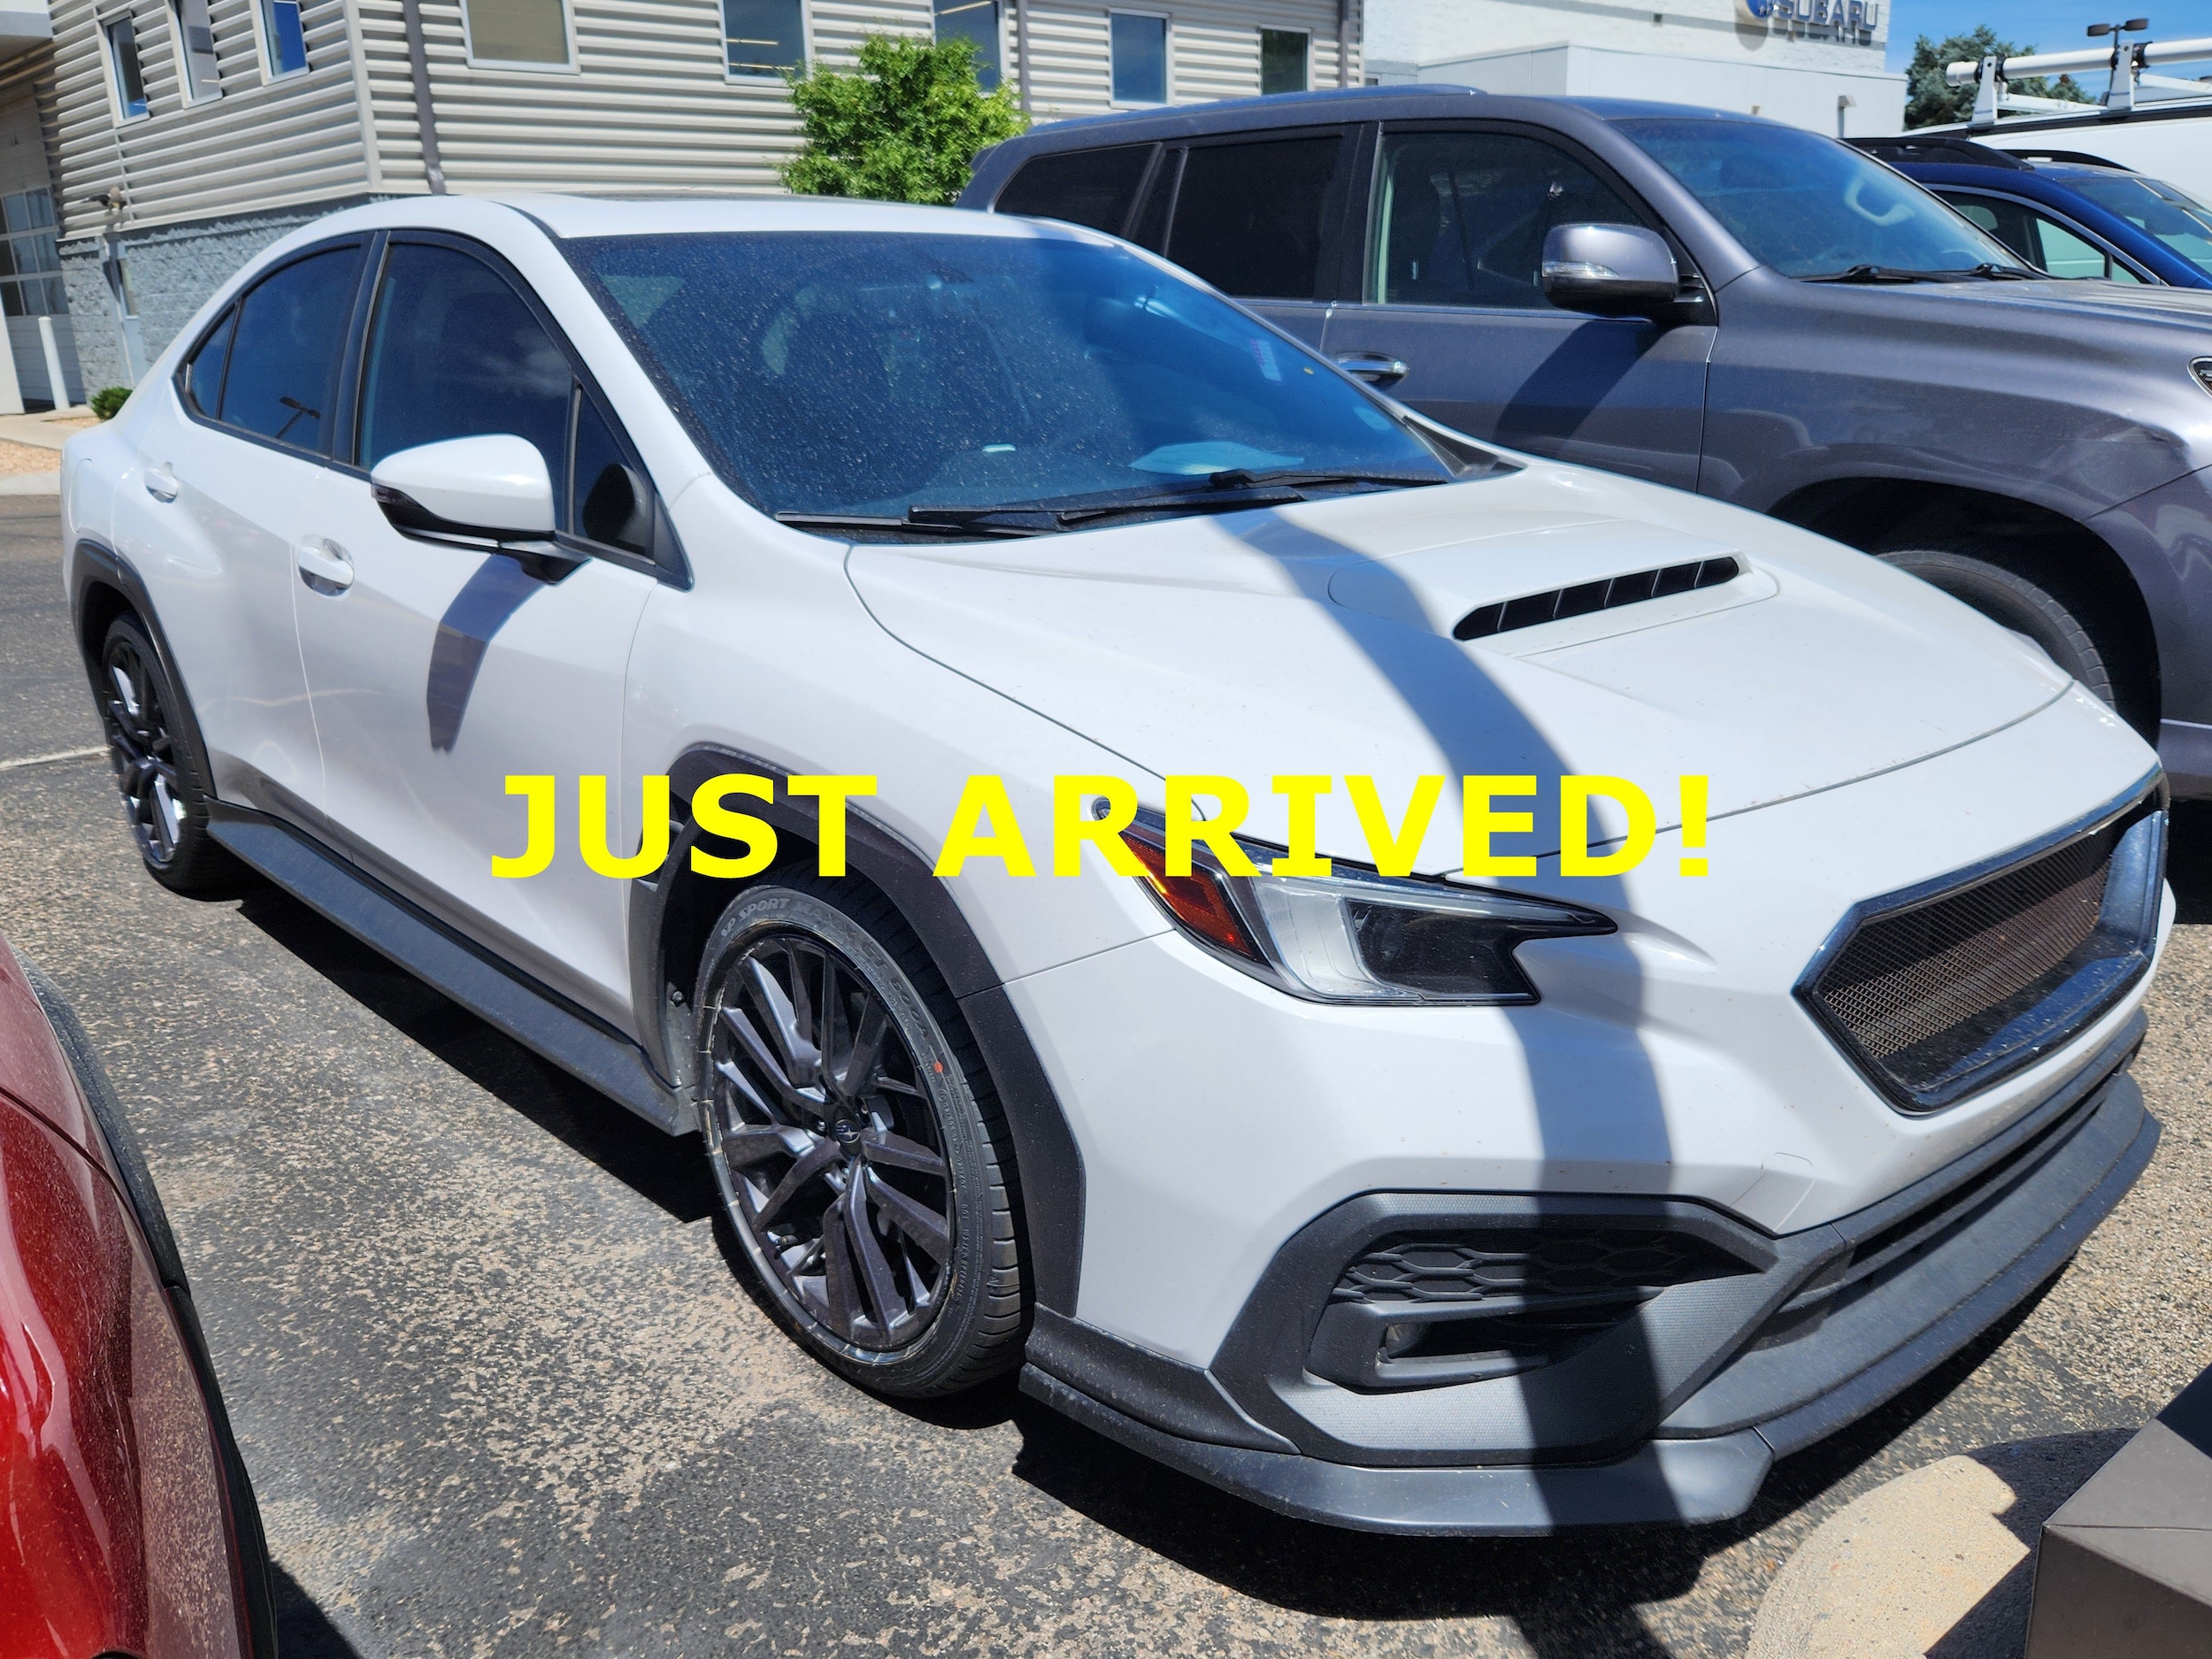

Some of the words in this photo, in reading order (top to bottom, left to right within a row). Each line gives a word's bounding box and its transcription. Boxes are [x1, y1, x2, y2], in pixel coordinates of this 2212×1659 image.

[1772, 0, 1878, 31] SUBARU
[719, 917, 736, 938] SP
[739, 897, 790, 920] SPORT
